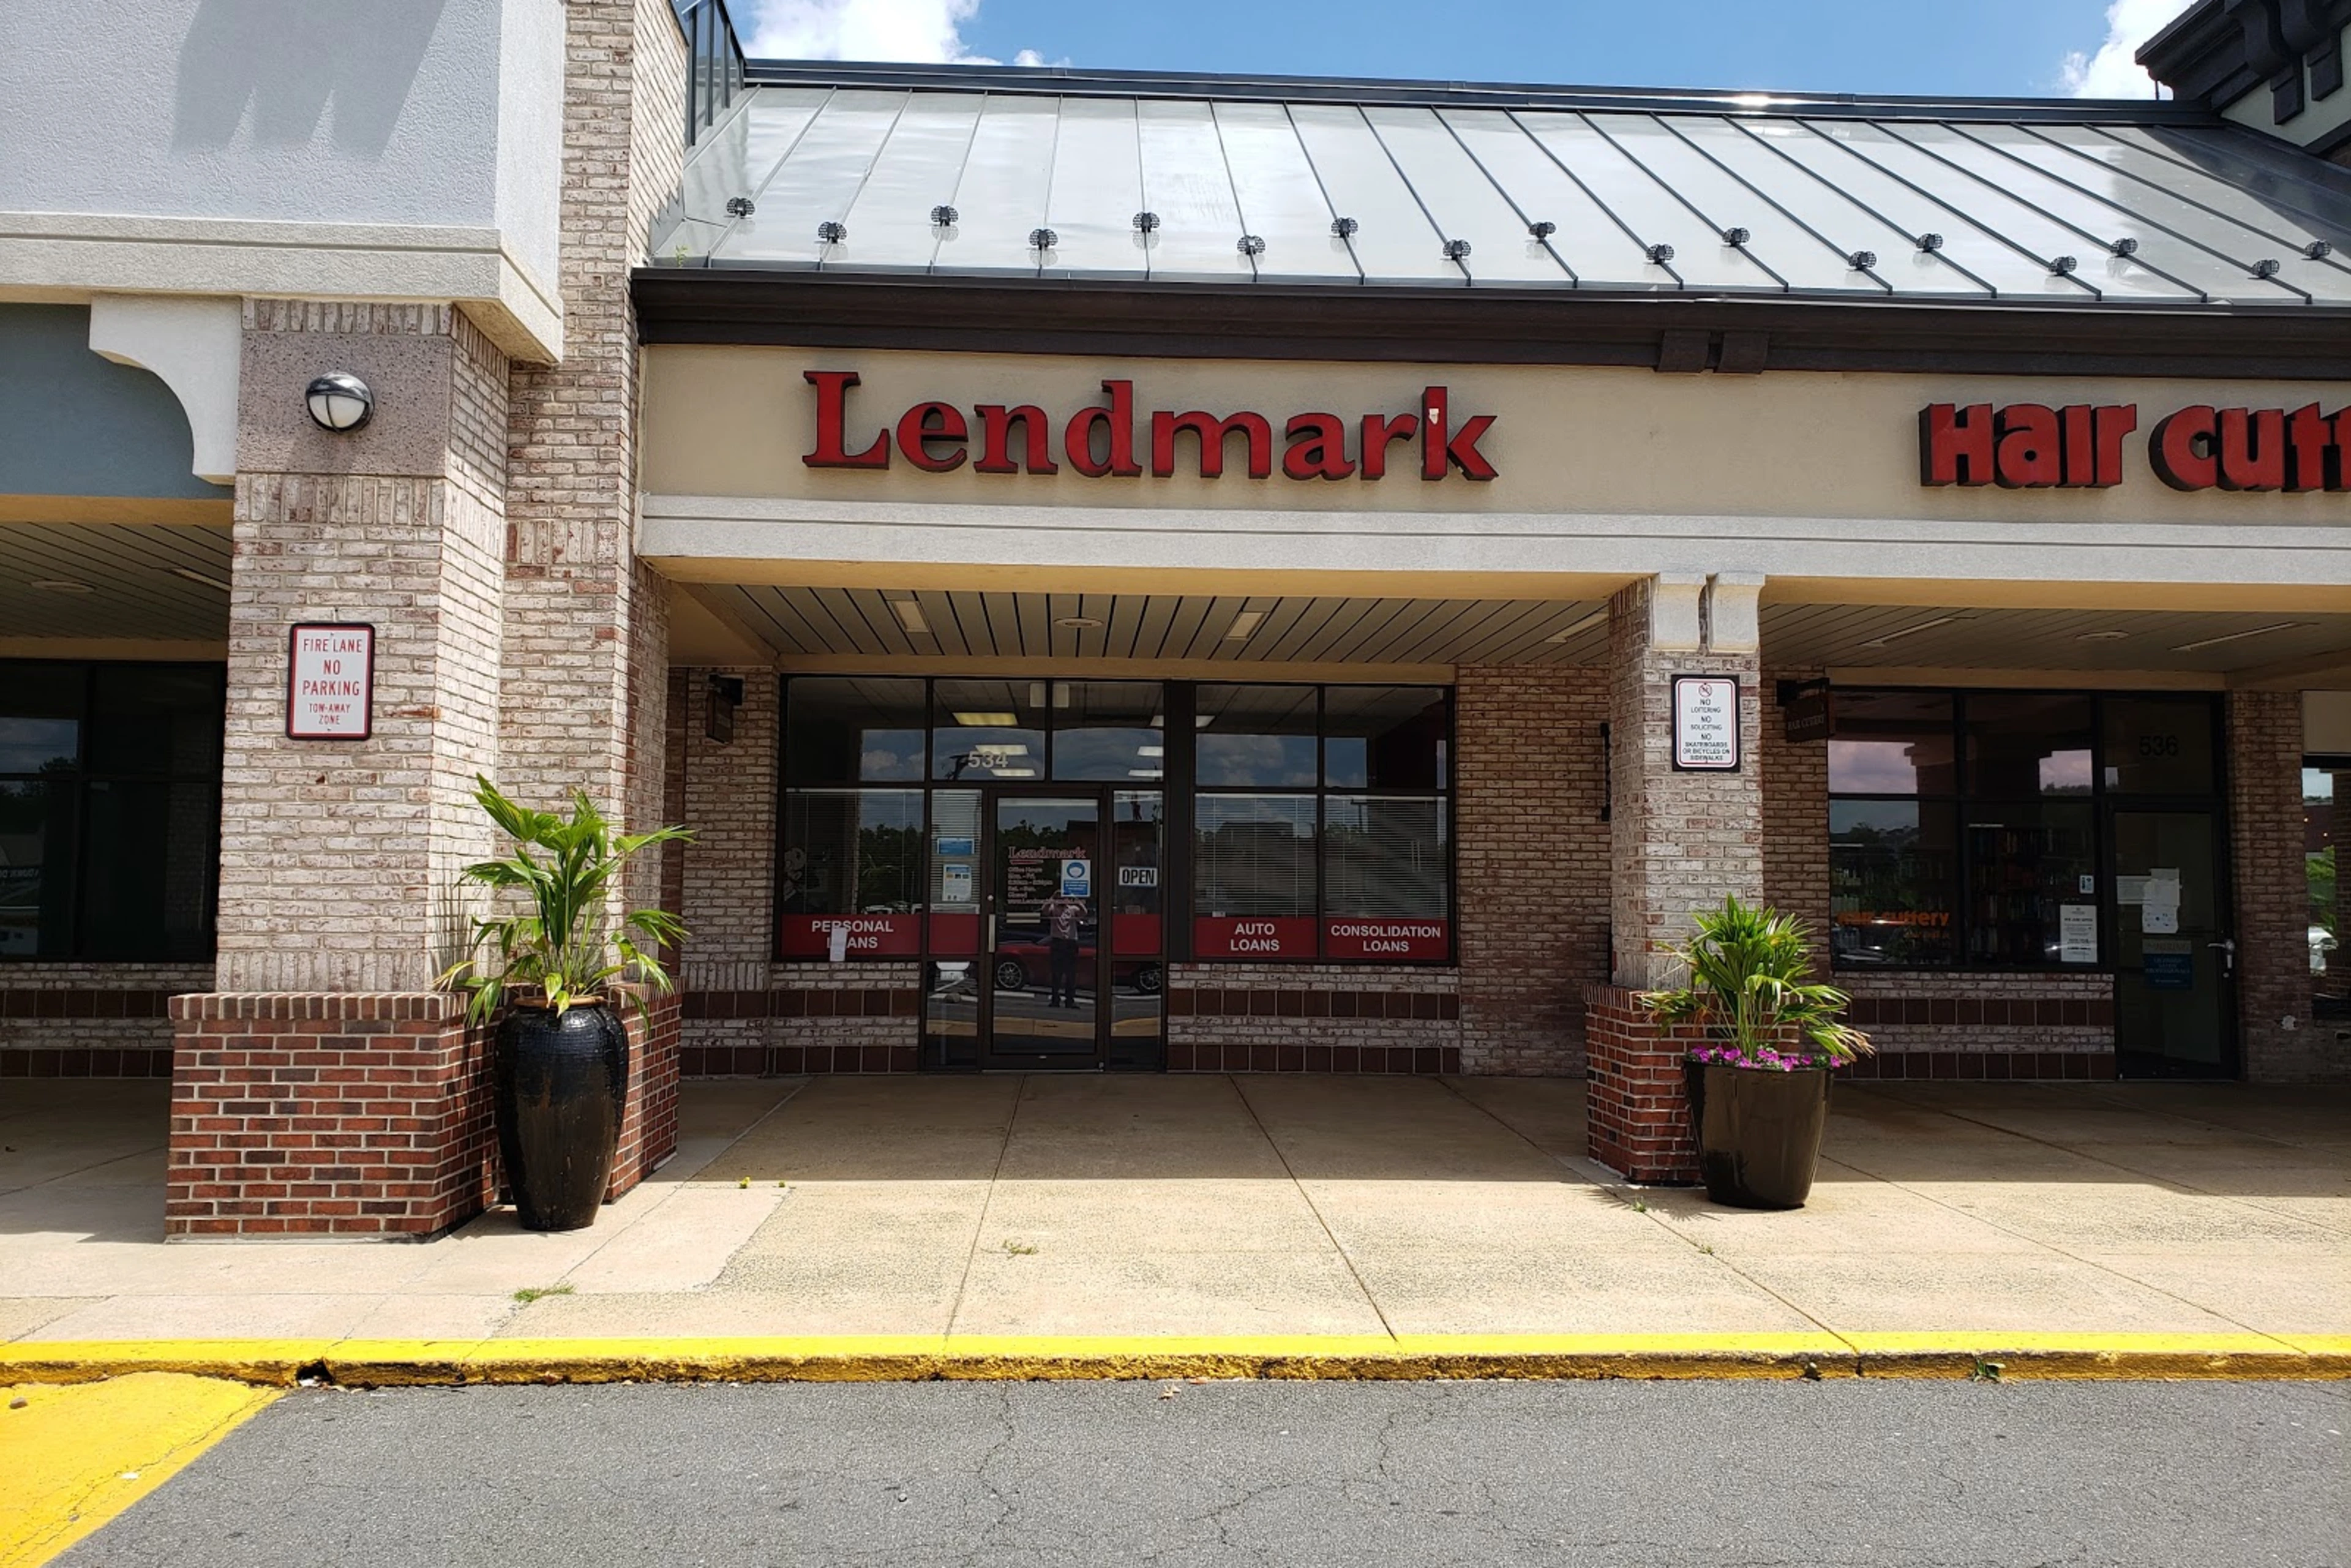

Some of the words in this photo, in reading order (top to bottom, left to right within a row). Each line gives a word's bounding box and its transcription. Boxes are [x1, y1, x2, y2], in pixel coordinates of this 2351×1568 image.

[802, 370, 1498, 482] Lendmark
[303, 639, 329, 652] FIRE
[333, 639, 362, 653] LANE
[323, 659, 341, 675] NO
[302, 680, 360, 696] PARKING
[309, 703, 351, 713] TOW-AWAY
[318, 715, 340, 725] ZONE
[2139, 735, 2178, 756] 536
[968, 751, 1009, 768] 534
[1008, 846, 1087, 858] Lendmark
[1122, 869, 1154, 883] OPEN
[812, 920, 894, 932] PERSONAL
[1234, 923, 1275, 936] AUTO
[1330, 925, 1441, 939] CONSOLIDATION
[827, 937, 878, 949] LANS
[1230, 939, 1280, 952] LOANS
[1362, 940, 1409, 953] LOANS
